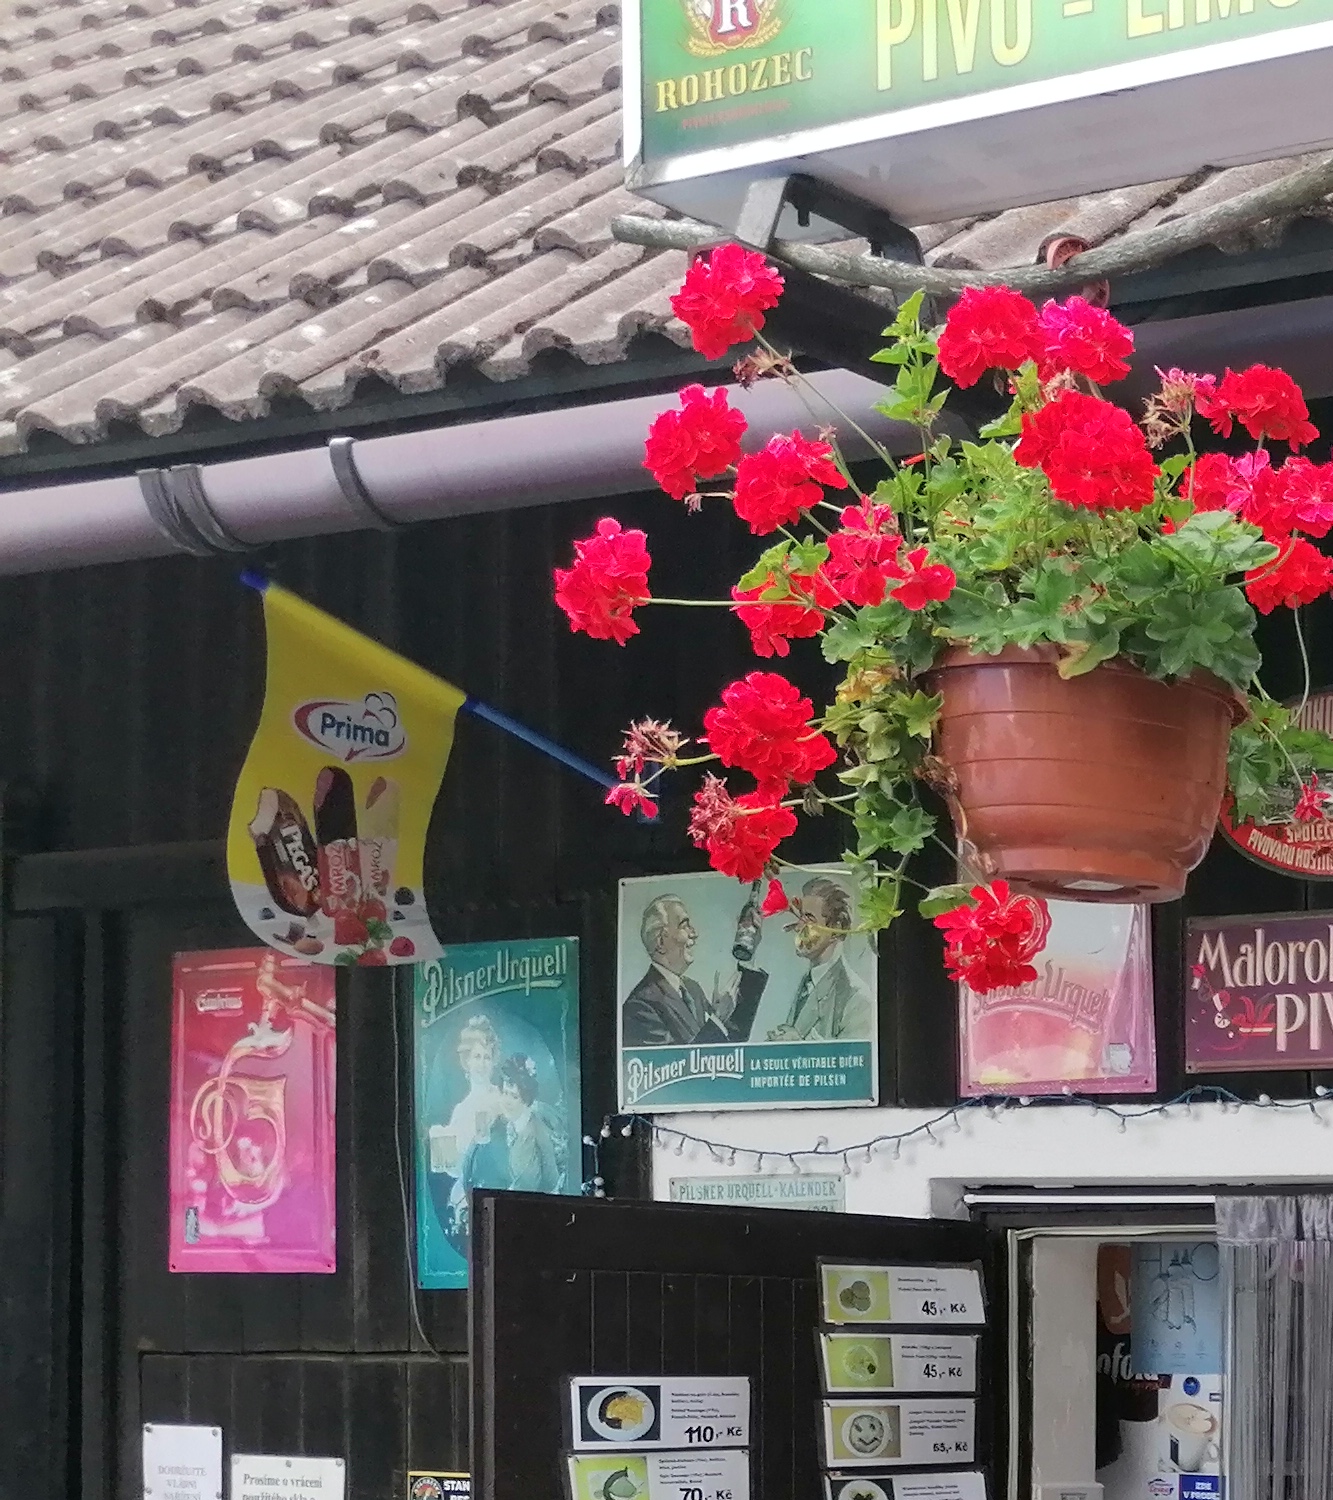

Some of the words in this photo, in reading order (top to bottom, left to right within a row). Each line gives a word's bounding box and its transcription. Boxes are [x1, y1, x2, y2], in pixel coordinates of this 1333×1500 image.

[655, 47, 813, 112] ROHOZEC
[320, 712, 390, 747] Prima
[422, 957, 496, 1022] Pilsner
[496, 944, 567, 994] Urquell
[750, 1059, 761, 1070] LA
[763, 1059, 790, 1070] SEULE
[792, 1054, 837, 1070] VÉRITABLE
[627, 1055, 686, 1102] Pilsner
[689, 1047, 745, 1080] Urquell
[750, 1074, 795, 1088] IMPORTÉE
[799, 1075, 811, 1087] DE
[813, 1074, 846, 1087] PILSEN
[679, 1184, 724, 1200] PILSNER
[727, 1424, 743, 1437] Kč
[243, 1473, 280, 1487] Prosíme
[291, 1474, 323, 1488] vrácení
[716, 1488, 732, 1500] Kč
